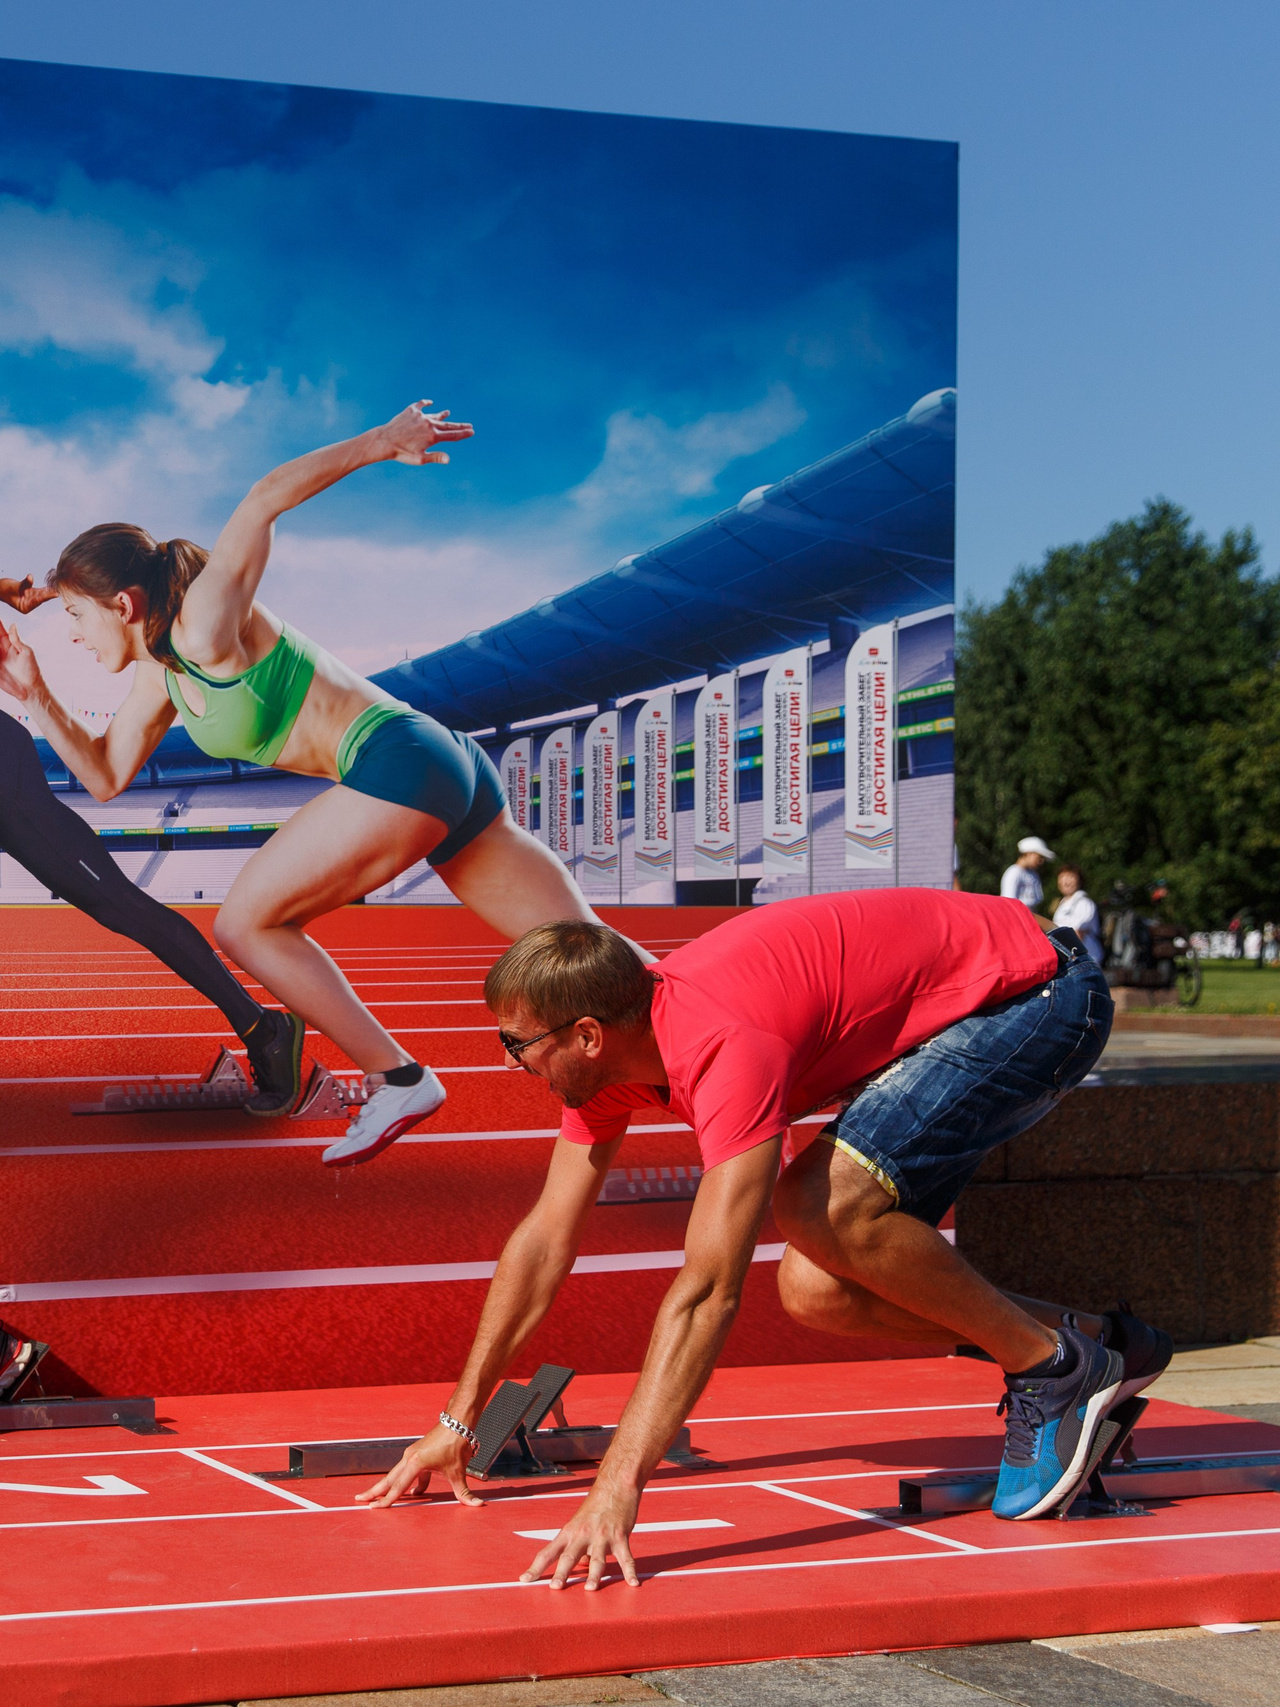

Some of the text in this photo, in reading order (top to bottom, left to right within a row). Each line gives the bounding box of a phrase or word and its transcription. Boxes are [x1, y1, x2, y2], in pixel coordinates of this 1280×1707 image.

[657, 730, 667, 840] ДОСТИГАЯ ЦЕЛИ!
[718, 713, 730, 754] ЦЕЛИ!
[790, 692, 802, 824] ДОСТИГАЯ ЦЕЛИ!
[857, 705, 865, 816] БЛАГОТВОРИТЕЛЬНЫЙ
[874, 672, 887, 815] ДОСТИГАЯ ЦЕЛИ!
[559, 758, 568, 851] ДОСТИГАЯ ЦЕЛИ!
[604, 744, 613, 845] ДОСТИГАЯ ЦЕЛИ!
[718, 759, 730, 832] ДОСТИГАЯ
